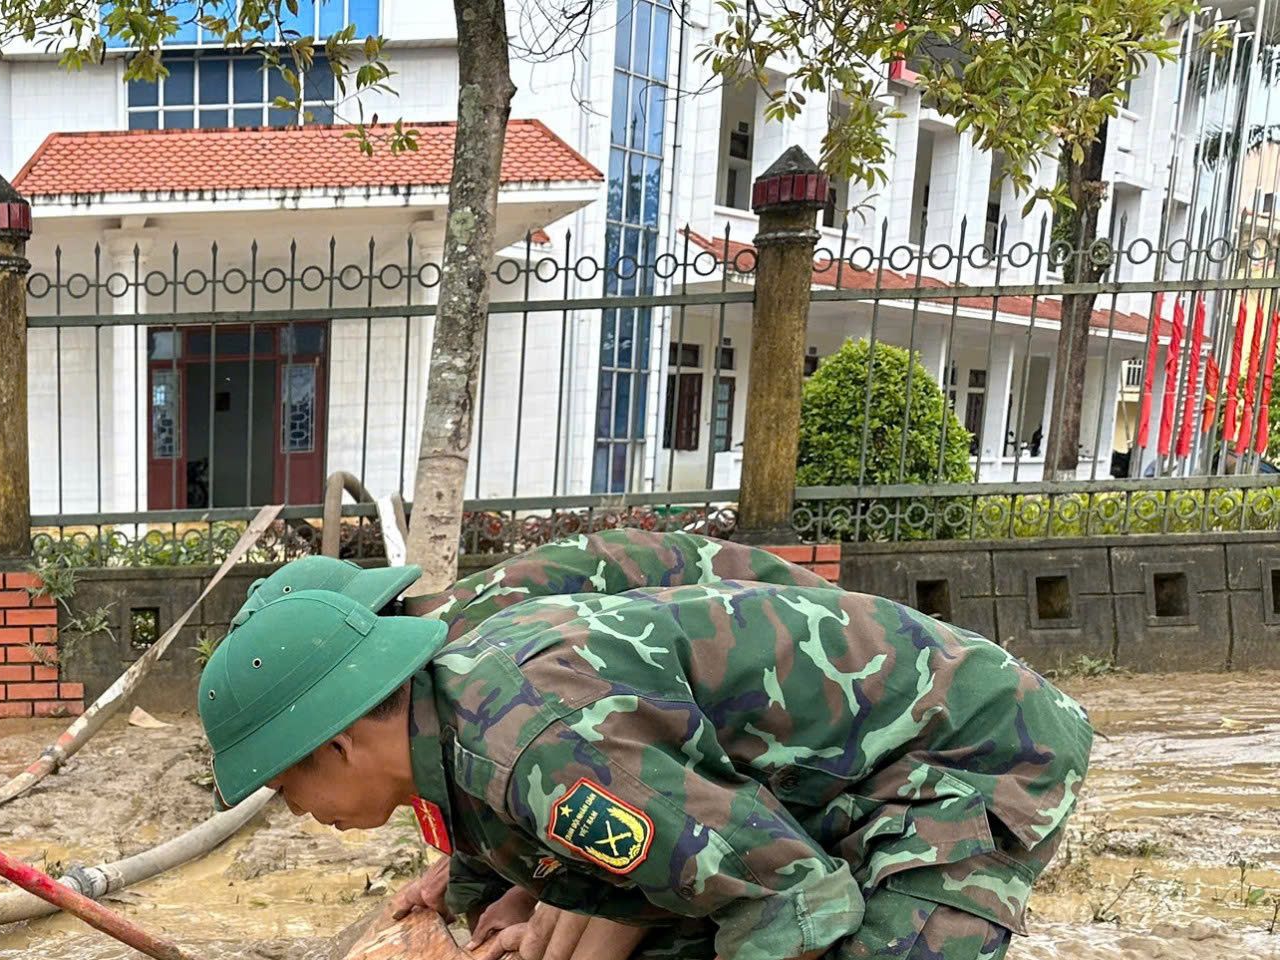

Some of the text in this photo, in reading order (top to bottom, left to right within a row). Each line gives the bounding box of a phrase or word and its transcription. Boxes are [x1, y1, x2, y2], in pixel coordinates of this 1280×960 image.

[585, 792, 597, 806] DÂN
[579, 810, 599, 837] VIỆT NAM
